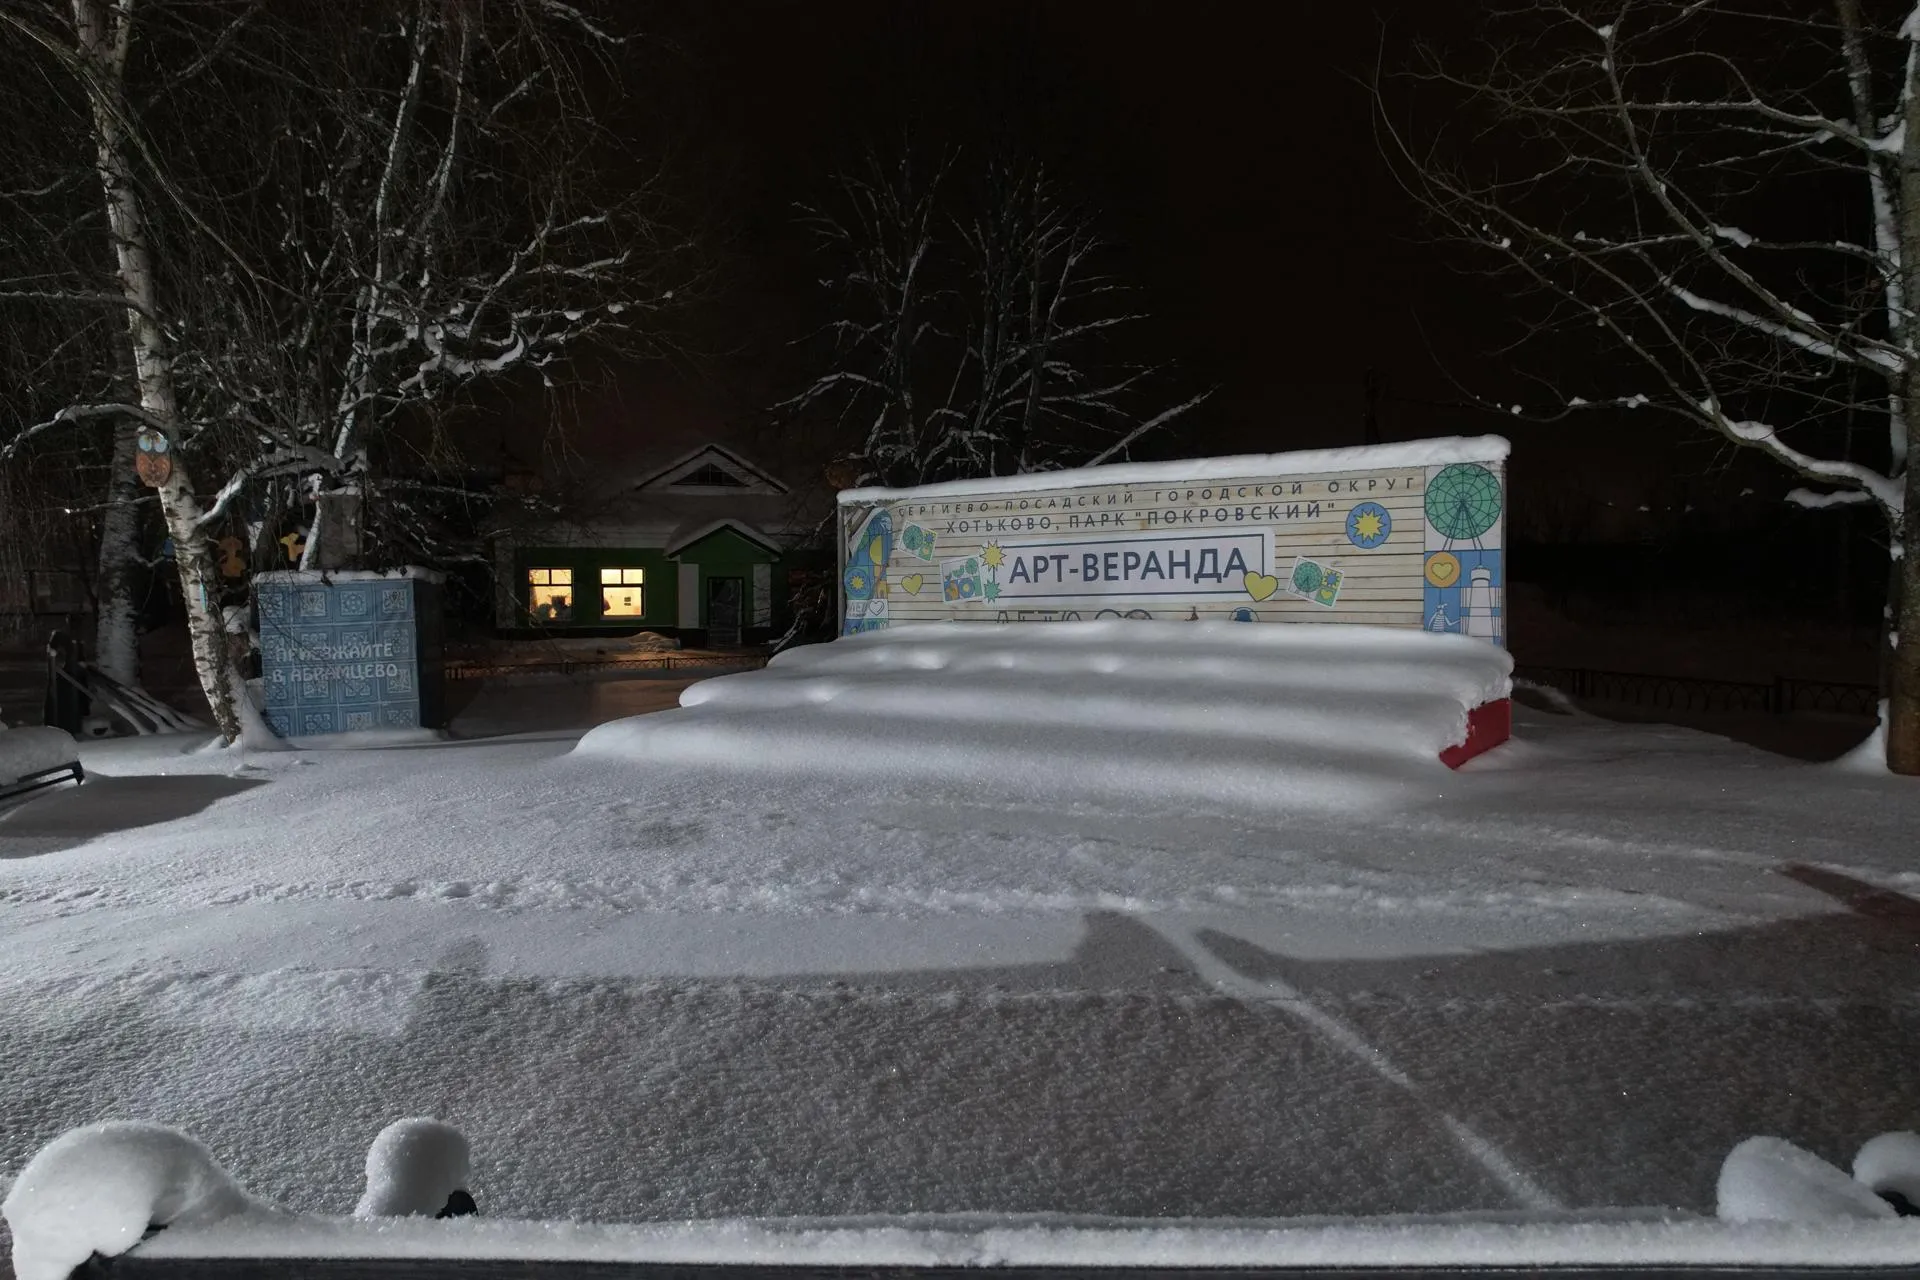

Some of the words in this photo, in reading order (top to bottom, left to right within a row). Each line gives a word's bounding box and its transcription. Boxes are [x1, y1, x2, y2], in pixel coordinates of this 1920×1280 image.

[1154, 481, 1302, 503] ГОРОДСКОЙ
[1327, 477, 1416, 494] ОКРУГ
[946, 516, 1060, 534] ХОТЬКОВО,
[1069, 512, 1126, 529] ПАРК
[1135, 500, 1336, 525] "ПОКРОВСКИЙ"
[1008, 547, 1248, 585] АРТ-ВЕРАНДА
[275, 641, 394, 663] ПРИЕЗЖАЙТЕ
[291, 663, 398, 683] АБРАМЦЕВО
